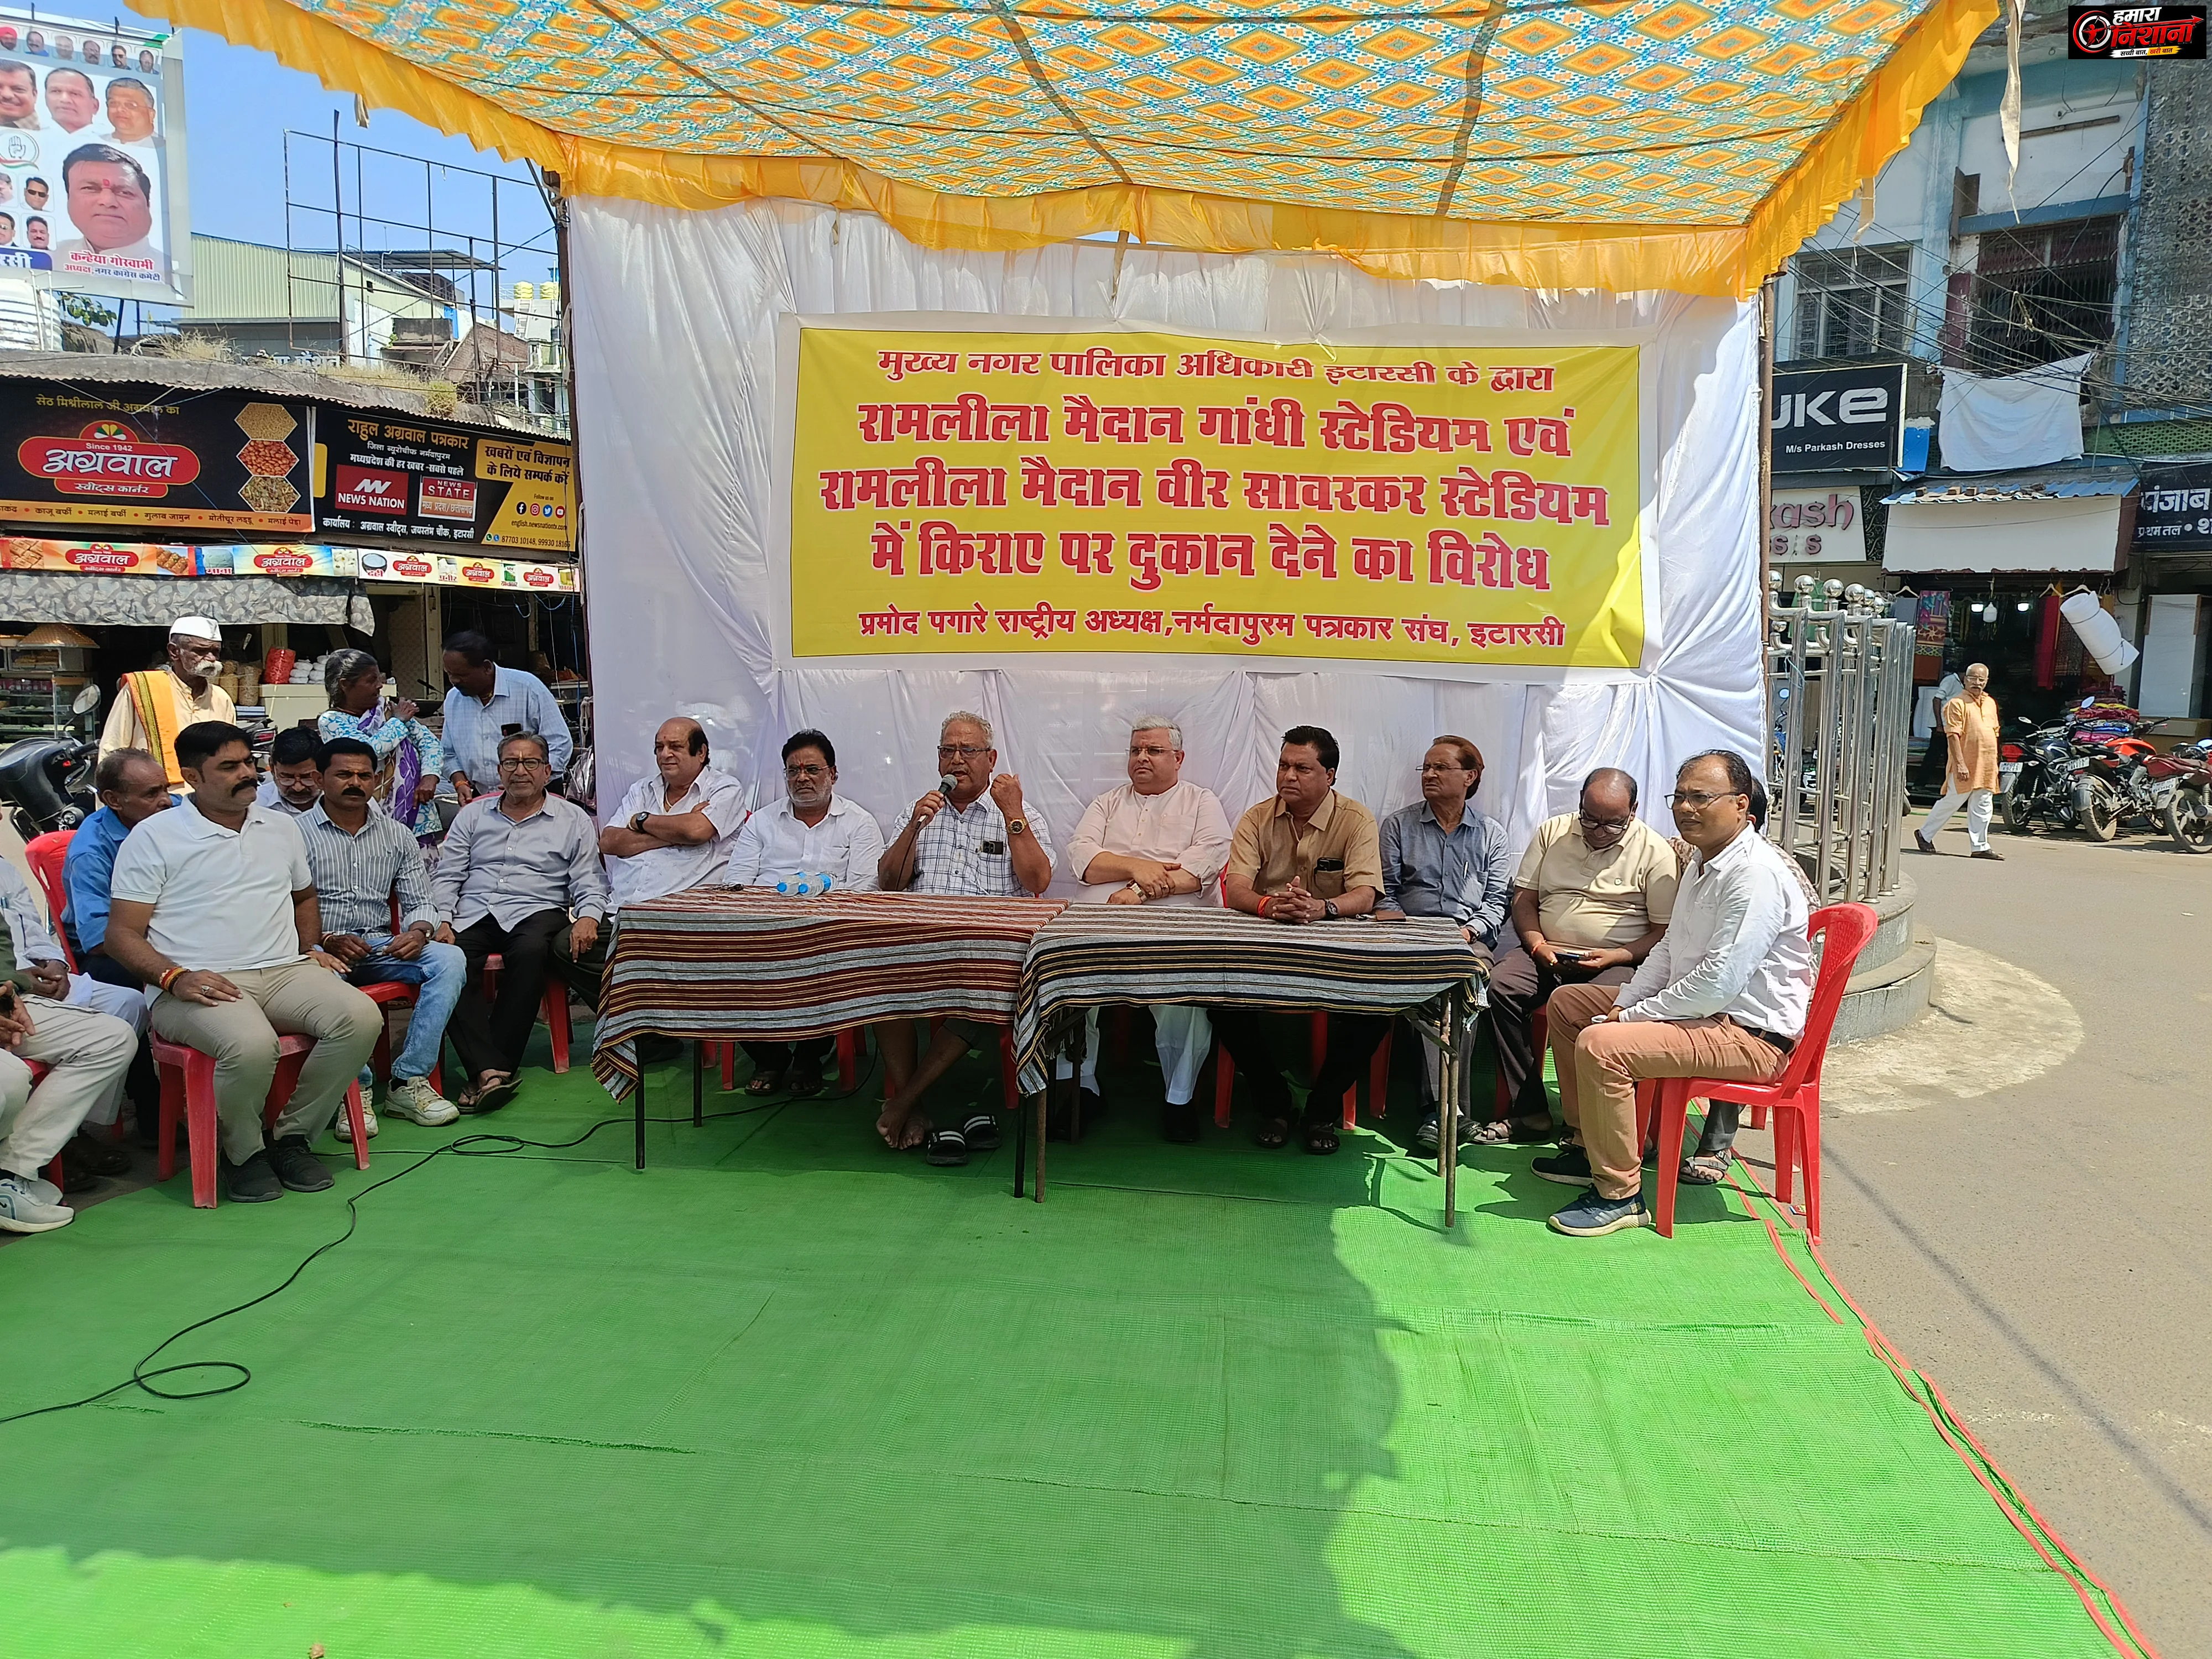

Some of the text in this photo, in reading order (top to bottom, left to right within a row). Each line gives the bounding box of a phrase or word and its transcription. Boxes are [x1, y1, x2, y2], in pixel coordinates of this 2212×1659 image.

[70, 251, 154, 270] कन्हैया गोस्वामी
[878, 347, 1554, 392] मुख्य नगर पालिका अधिकारी इटारसी के द्वारा
[35, 394, 54, 406] सेठ
[57, 395, 103, 409] मिश्रीलाल
[106, 399, 121, 411] जी
[166, 405, 180, 414] का
[347, 419, 469, 450] राहुल अग्रवाल पत्रकार
[858, 393, 1576, 457] रामलीला मैदान गांधी स्टेडियम एवं
[367, 441, 384, 451] जिला
[419, 449, 451, 461] नर्मदापुरम
[486, 445, 571, 468] खबरों एवं विज्ञापन
[1786, 440, 1885, 453] M/s Parkash Dresses
[43, 449, 178, 477] अग्रवाल
[350, 454, 383, 466] मध्यप्रदेश
[384, 457, 395, 467] की
[397, 460, 405, 468] हर
[447, 465, 464, 476] पहले
[487, 462, 570, 485] के लिये सम्पर्क करें
[74, 482, 149, 493] स्वीट्स कार्नर
[428, 486, 470, 499] STATE
[819, 456, 1610, 526] रामलीला मैदान वीर सावरकर स्टेडियम
[338, 493, 405, 509] NEWS NATION
[35, 508, 55, 517] काजू
[88, 508, 108, 517] मलाई
[169, 514, 190, 522] जामुन
[208, 513, 234, 524] मोतीचूर
[268, 517, 286, 525] मलाई
[322, 515, 350, 529] कार्यालय
[360, 521, 384, 532] अग्रवाल
[453, 527, 474, 540] इटारसी
[2137, 525, 2162, 538] प्रथम
[2162, 525, 2182, 536] तल
[502, 535, 518, 544] 87703
[538, 539, 555, 547] 99930
[74, 553, 131, 565] अग्रवाल
[262, 557, 306, 567] अग्रवाल
[871, 520, 1551, 591] में किराए पर दुकान देने का विरोध
[858, 604, 920, 637] प्रमोद
[927, 603, 988, 634] पगारे
[995, 601, 1076, 639] राष्ट्रीय
[1303, 613, 1394, 641] पत्रकार
[1401, 613, 1459, 648] संघ,
[1467, 616, 1565, 649] इटारसी
